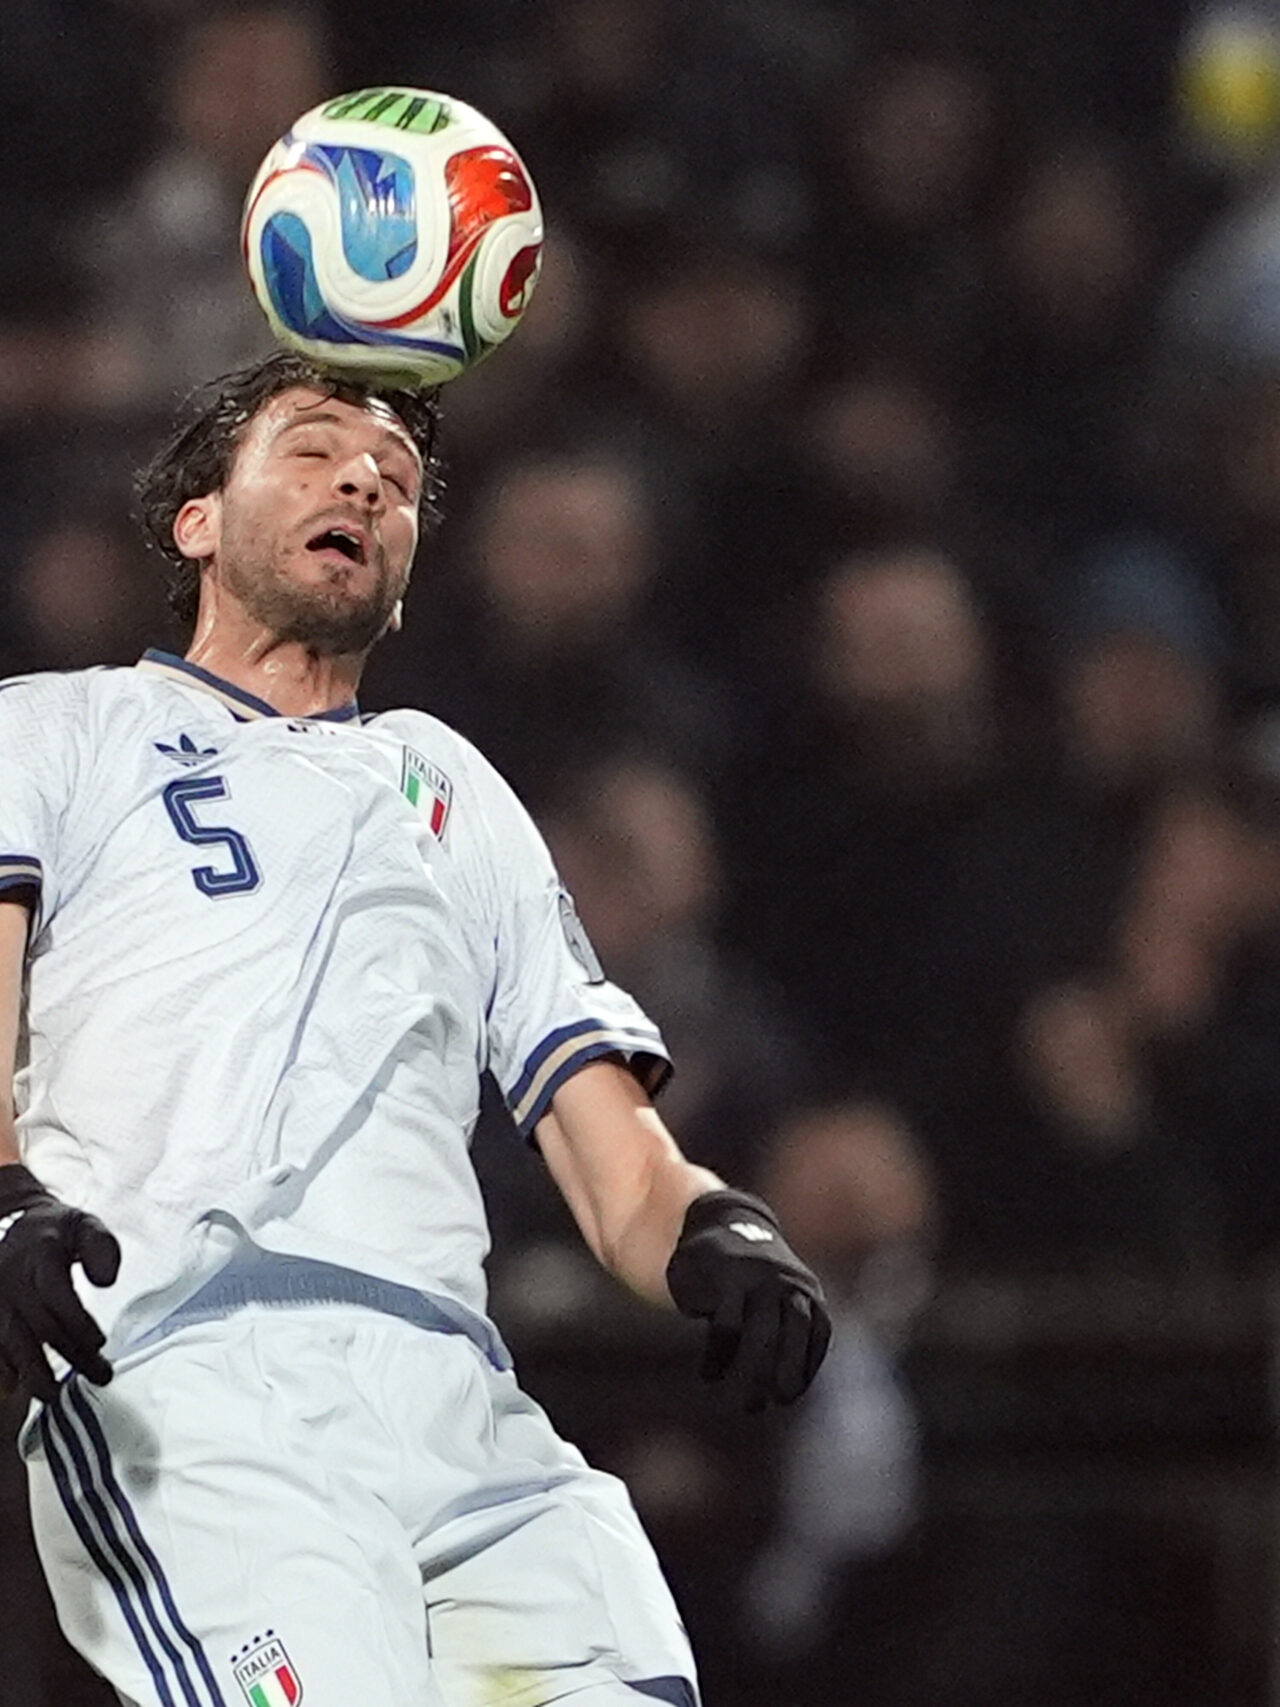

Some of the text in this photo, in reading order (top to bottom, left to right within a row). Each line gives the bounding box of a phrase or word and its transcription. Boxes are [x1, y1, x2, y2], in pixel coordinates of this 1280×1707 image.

[407, 751, 448, 797] ITALIA
[162, 775, 265, 901] 5
[238, 1647, 281, 1682] ITALIA
